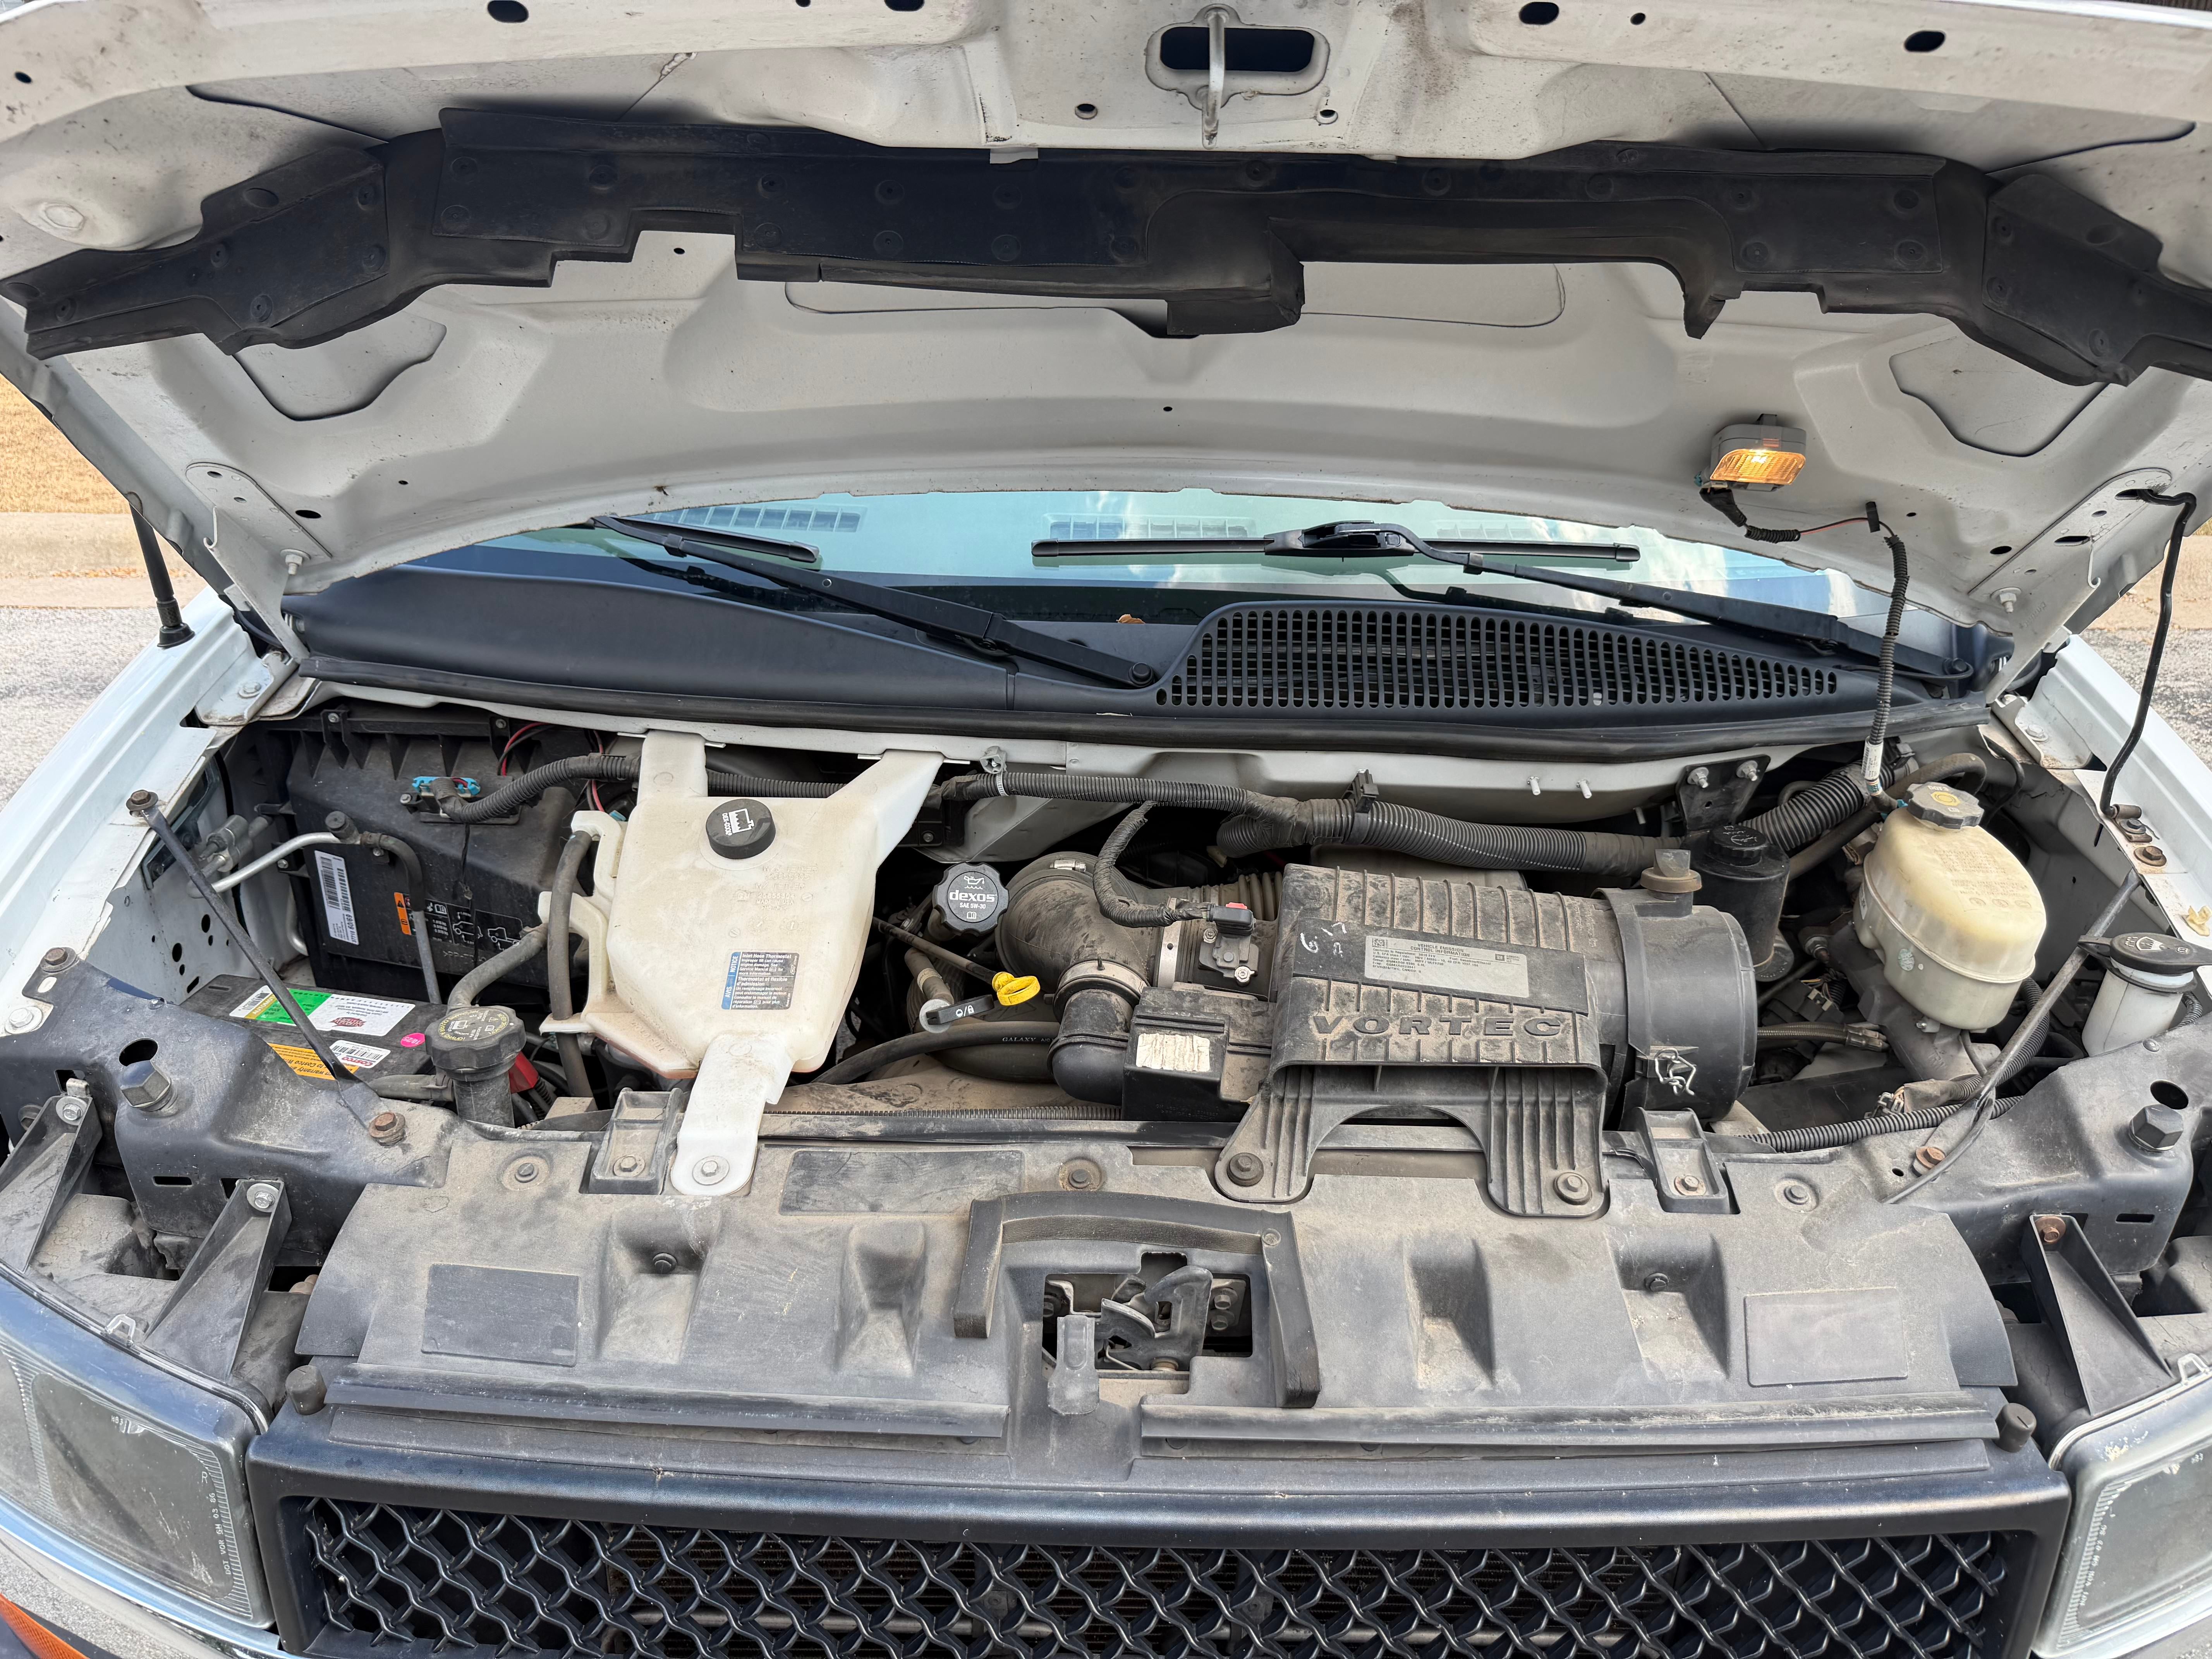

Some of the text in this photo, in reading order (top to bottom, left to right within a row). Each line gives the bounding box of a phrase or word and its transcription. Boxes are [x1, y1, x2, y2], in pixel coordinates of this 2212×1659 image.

[949, 890, 995, 902] dexos
[346, 914, 354, 930] 60/69
[730, 956, 738, 972] NOTICE
[1313, 1015, 1561, 1036] VORTEC
[111, 1415, 123, 1425] HB3
[212, 1508, 219, 1518] 03
[215, 1524, 223, 1535] GM
[223, 1560, 232, 1575] DOT
